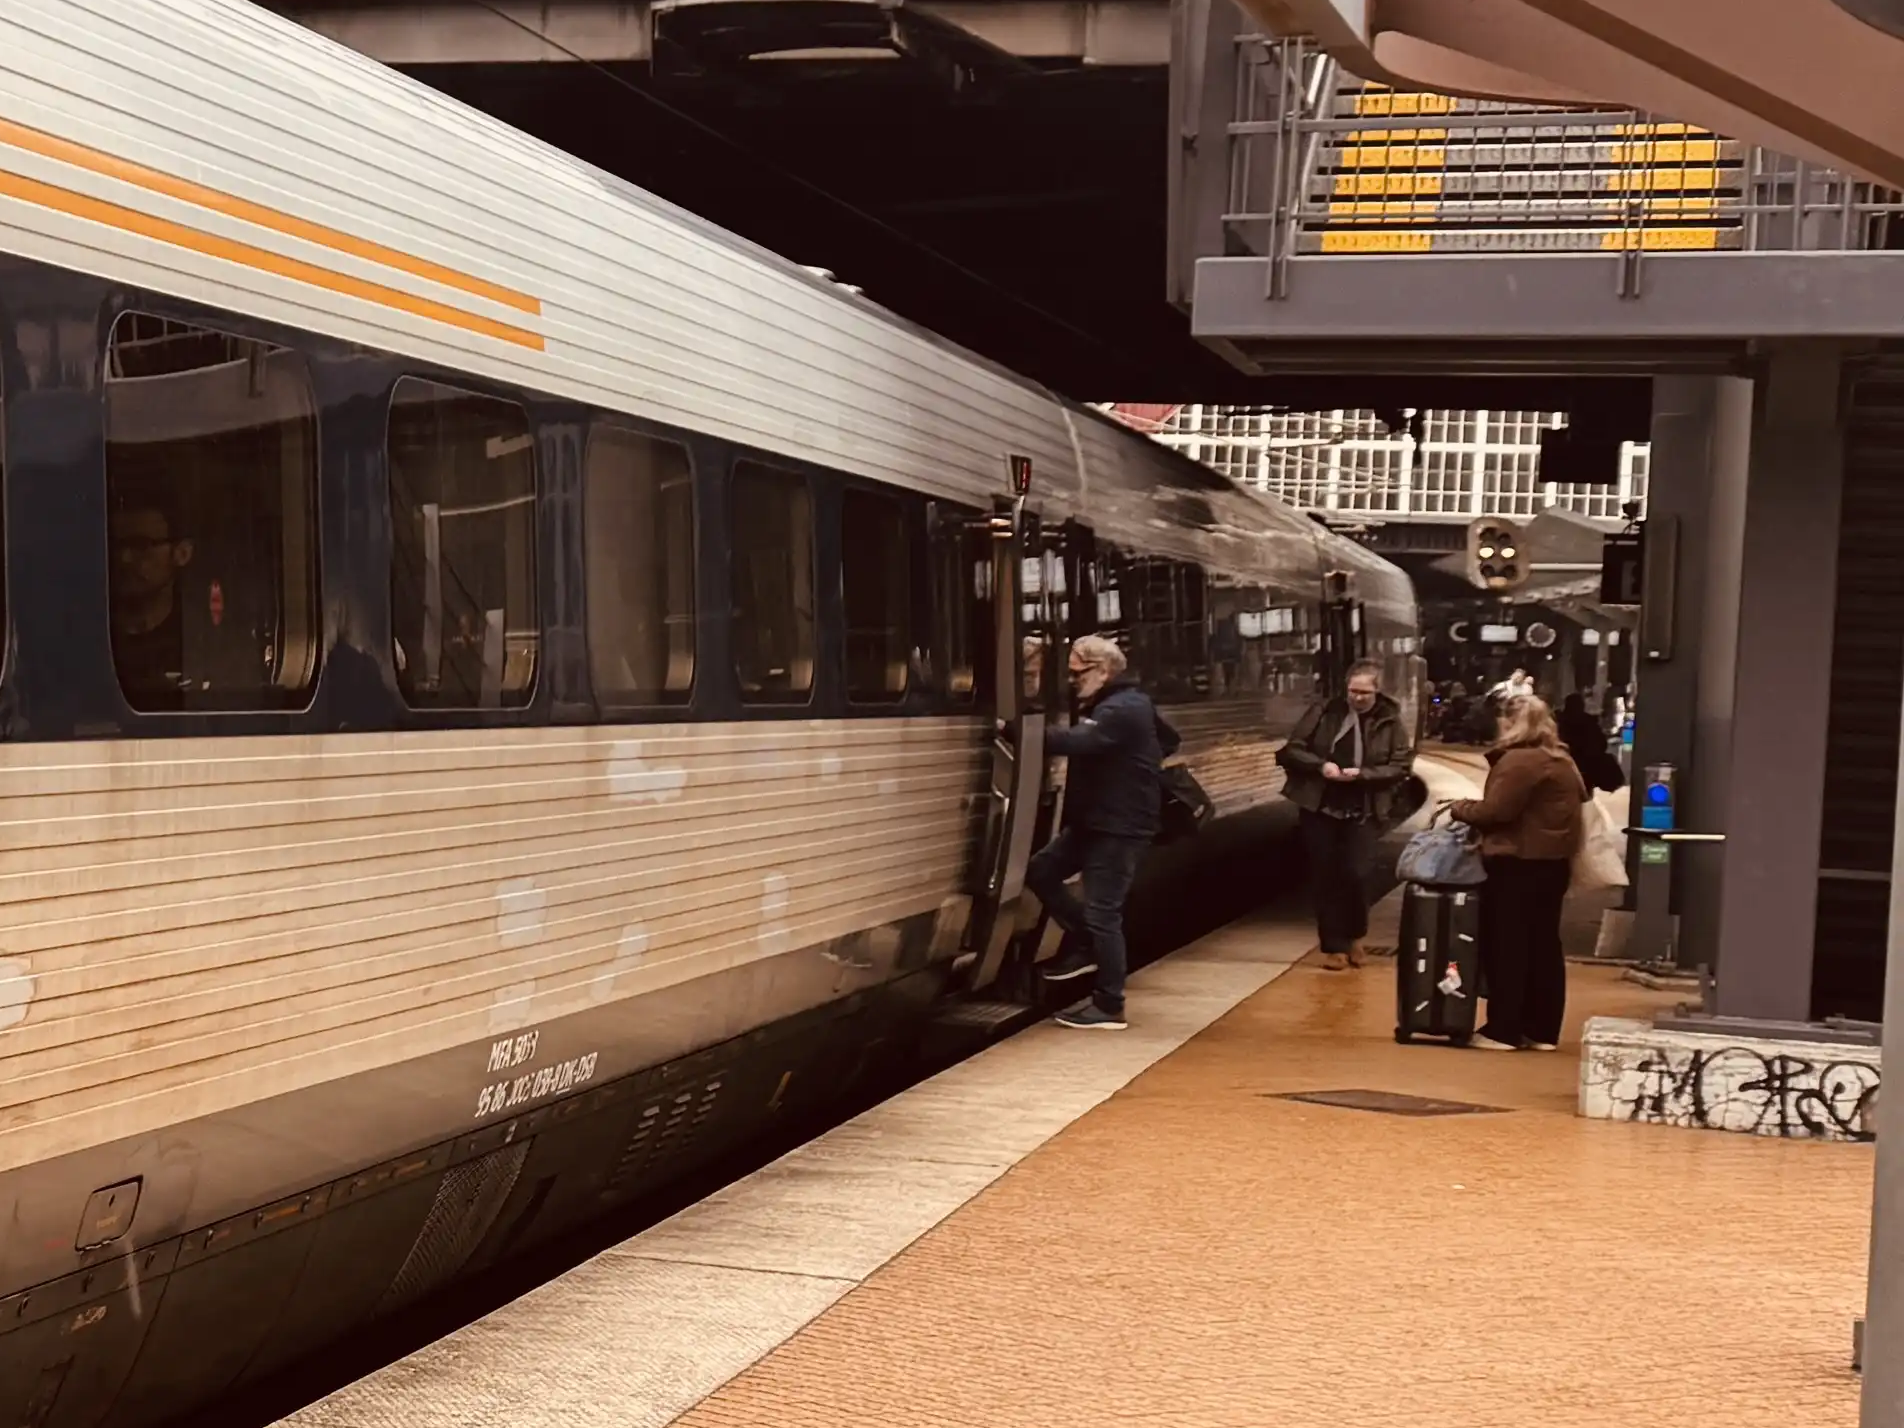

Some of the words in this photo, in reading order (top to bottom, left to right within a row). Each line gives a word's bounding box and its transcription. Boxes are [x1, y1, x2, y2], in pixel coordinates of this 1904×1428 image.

[487, 1037, 514, 1073] MFA
[474, 1084, 495, 1119] 95
[490, 1080, 510, 1113] 86
